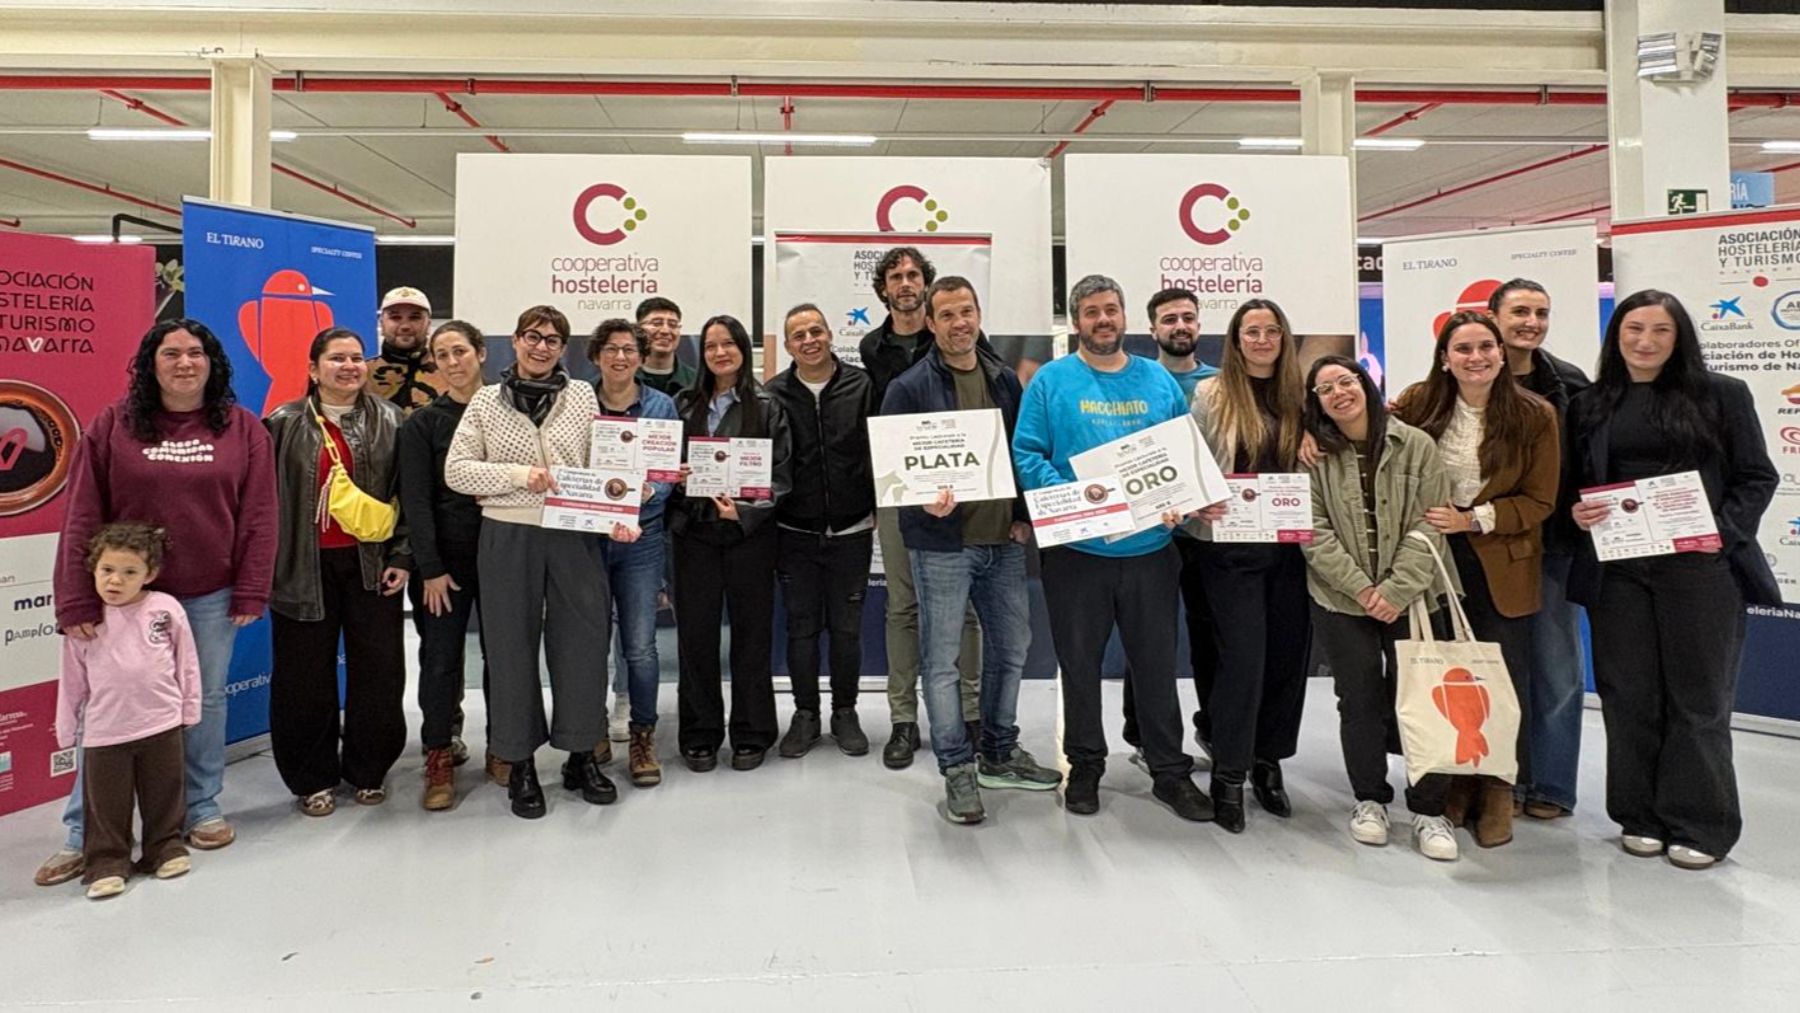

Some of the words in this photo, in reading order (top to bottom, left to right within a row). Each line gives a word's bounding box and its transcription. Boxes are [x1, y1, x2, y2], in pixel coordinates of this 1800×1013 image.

[207, 232, 221, 244] EL
[222, 235, 265, 250] TIRANO
[551, 252, 659, 276] cooperativa
[1160, 252, 1263, 276] cooperativa
[1403, 261, 1416, 271] EL
[1416, 258, 1458, 270] TIRANO
[1719, 258, 1727, 268] Y
[552, 273, 658, 293] hostelería
[1161, 273, 1263, 293] hostelería
[577, 299, 632, 310] navarra
[1197, 299, 1239, 310] avarra
[1700, 320, 1754, 332] CaixaBank
[1700, 339, 1781, 350] olaboradores
[1702, 350, 1754, 361] ciación
[1758, 351, 1777, 359] de
[1763, 362, 1781, 371] de
[904, 451, 981, 471] PLATA
[1125, 465, 1178, 495] ORO
[1272, 497, 1301, 507] ORO
[225, 671, 272, 697] operativ
